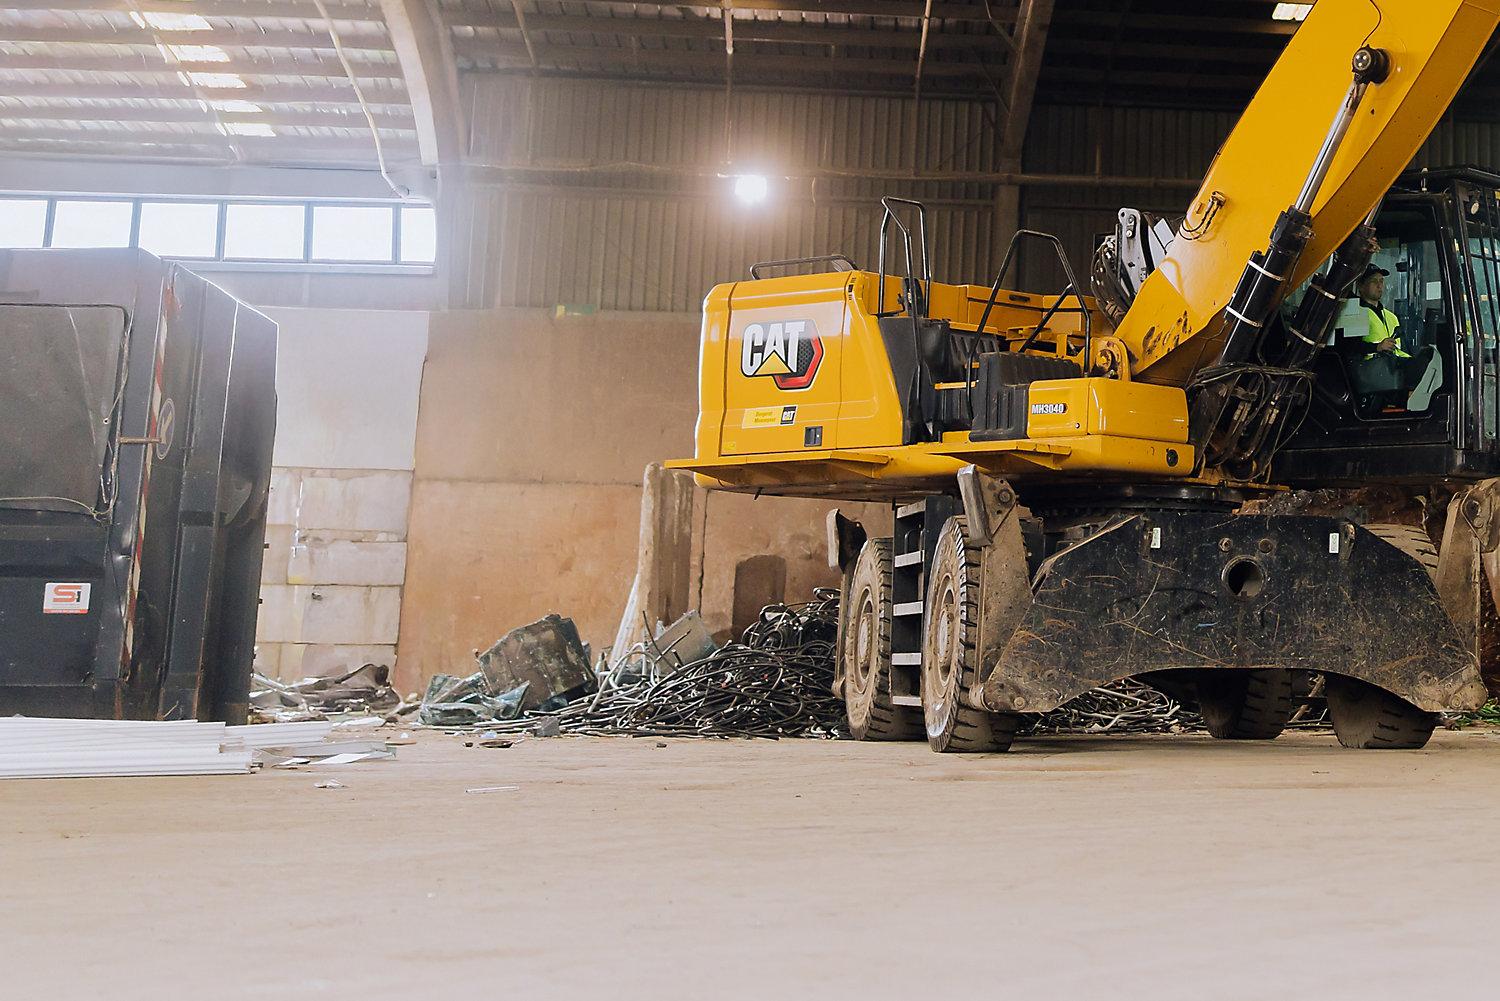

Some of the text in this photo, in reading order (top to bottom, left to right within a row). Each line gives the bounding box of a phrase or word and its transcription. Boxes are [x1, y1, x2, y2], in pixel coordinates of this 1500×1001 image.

[742, 321, 806, 376] CAT
[1031, 403, 1064, 414] MH3040
[782, 410, 796, 421] CAT
